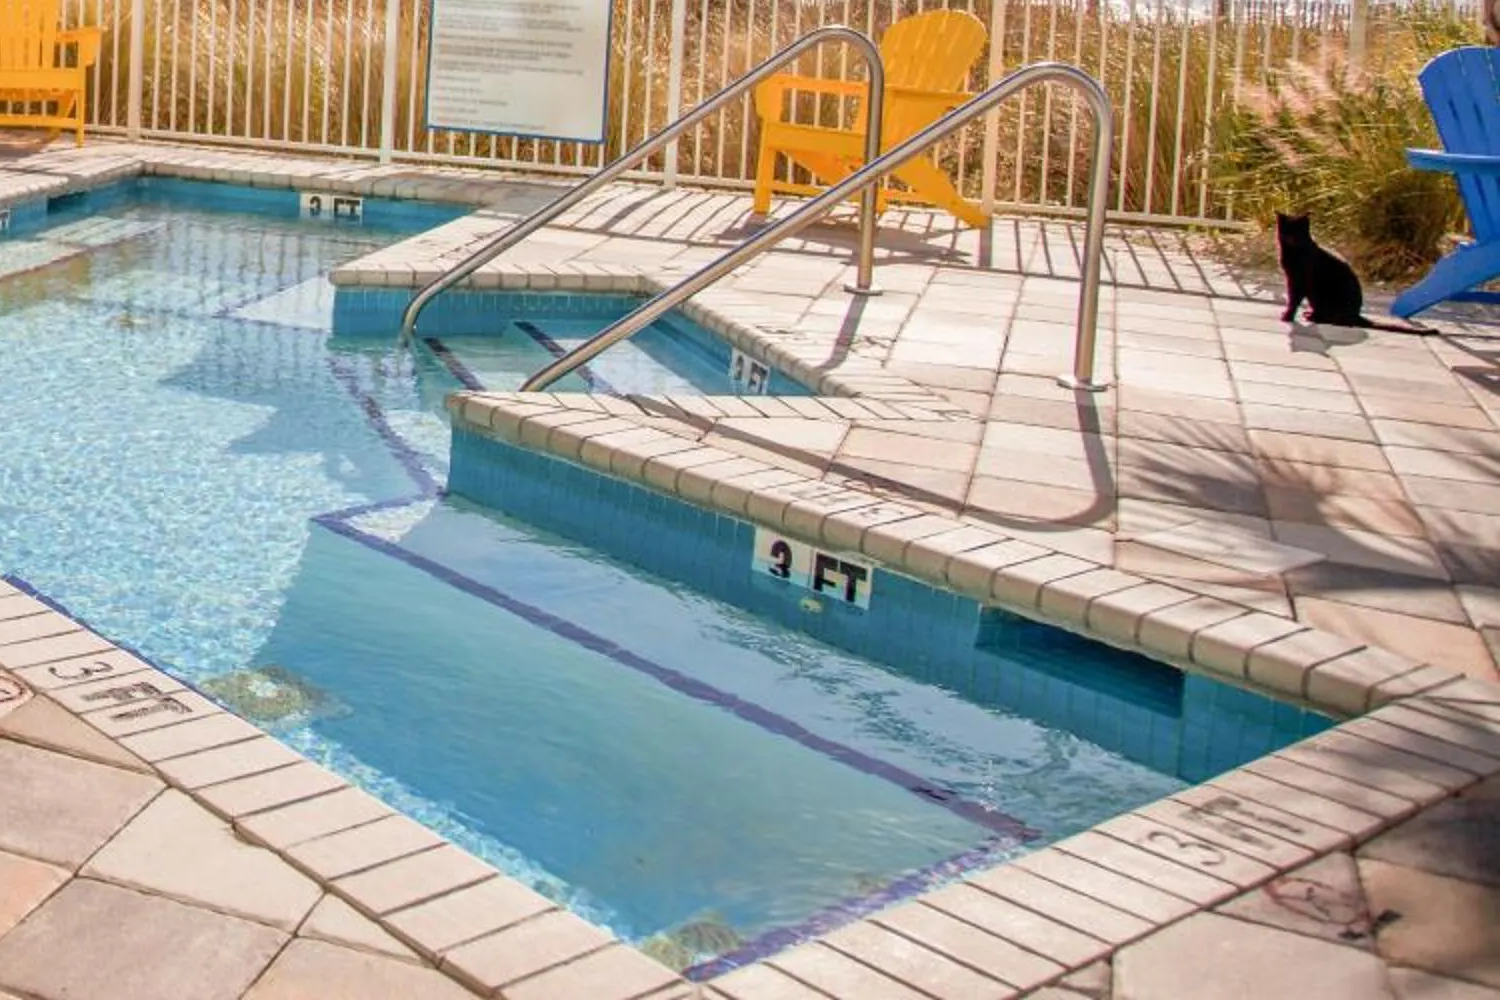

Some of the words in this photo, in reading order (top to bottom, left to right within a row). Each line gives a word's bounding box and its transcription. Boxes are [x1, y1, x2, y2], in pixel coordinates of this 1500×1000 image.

[768, 540, 793, 579] 3
[813, 552, 868, 604] FT
[48, 661, 114, 681] 3
[81, 681, 194, 721] FT
[1146, 830, 1227, 867] 3
